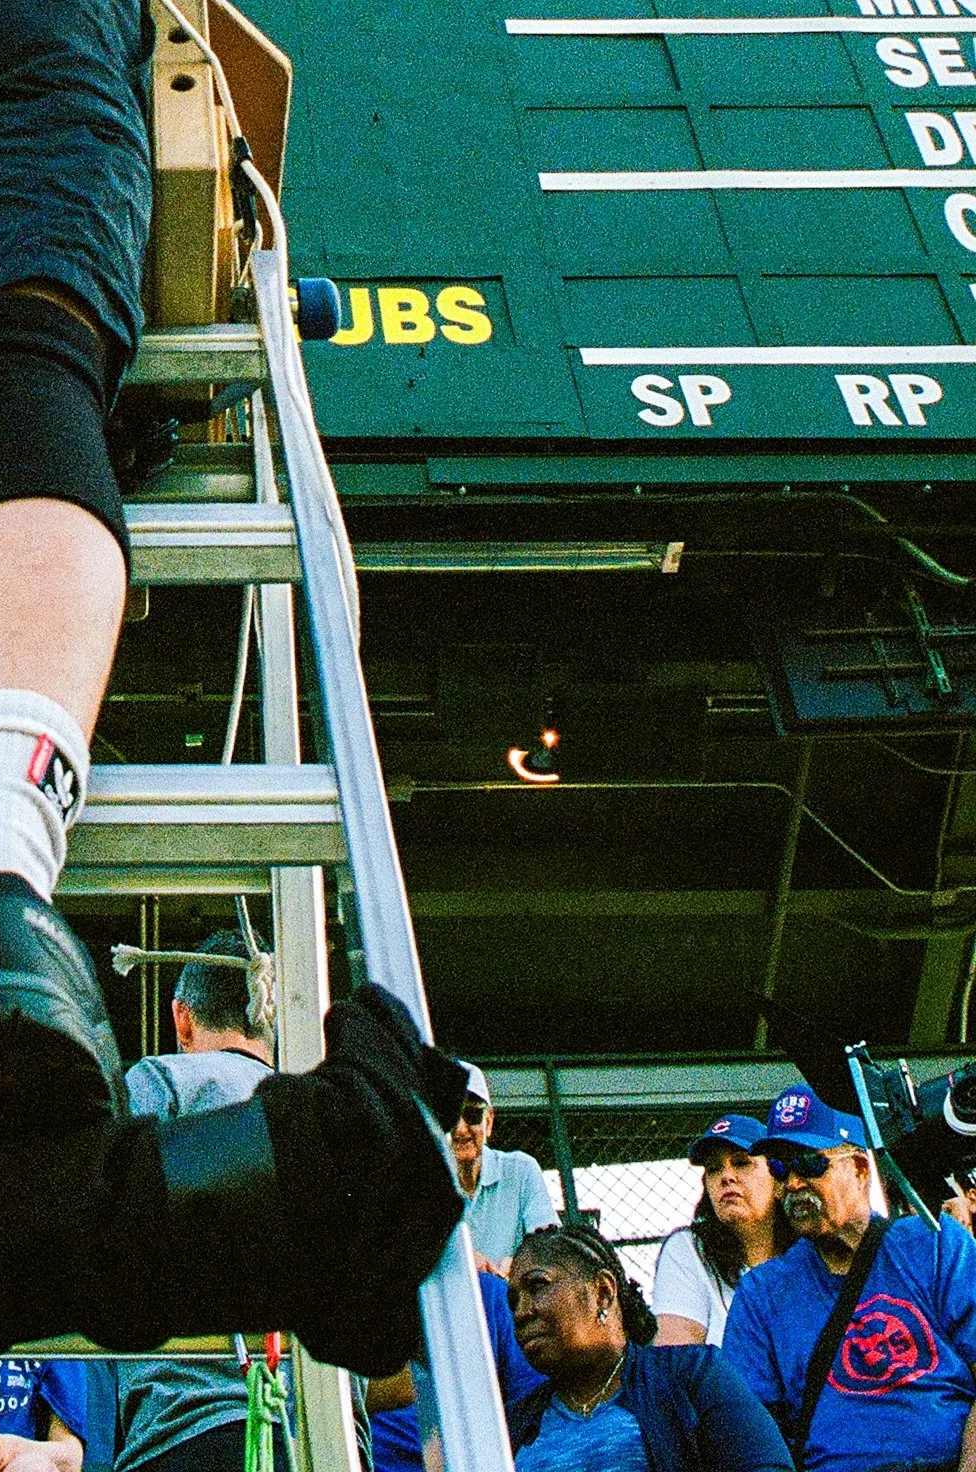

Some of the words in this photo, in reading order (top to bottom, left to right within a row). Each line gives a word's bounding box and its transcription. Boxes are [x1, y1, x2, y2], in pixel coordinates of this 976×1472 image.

[875, 36, 976, 89] SE
[288, 286, 493, 346] UBS
[630, 375, 731, 427] SP
[835, 375, 942, 426] RP
